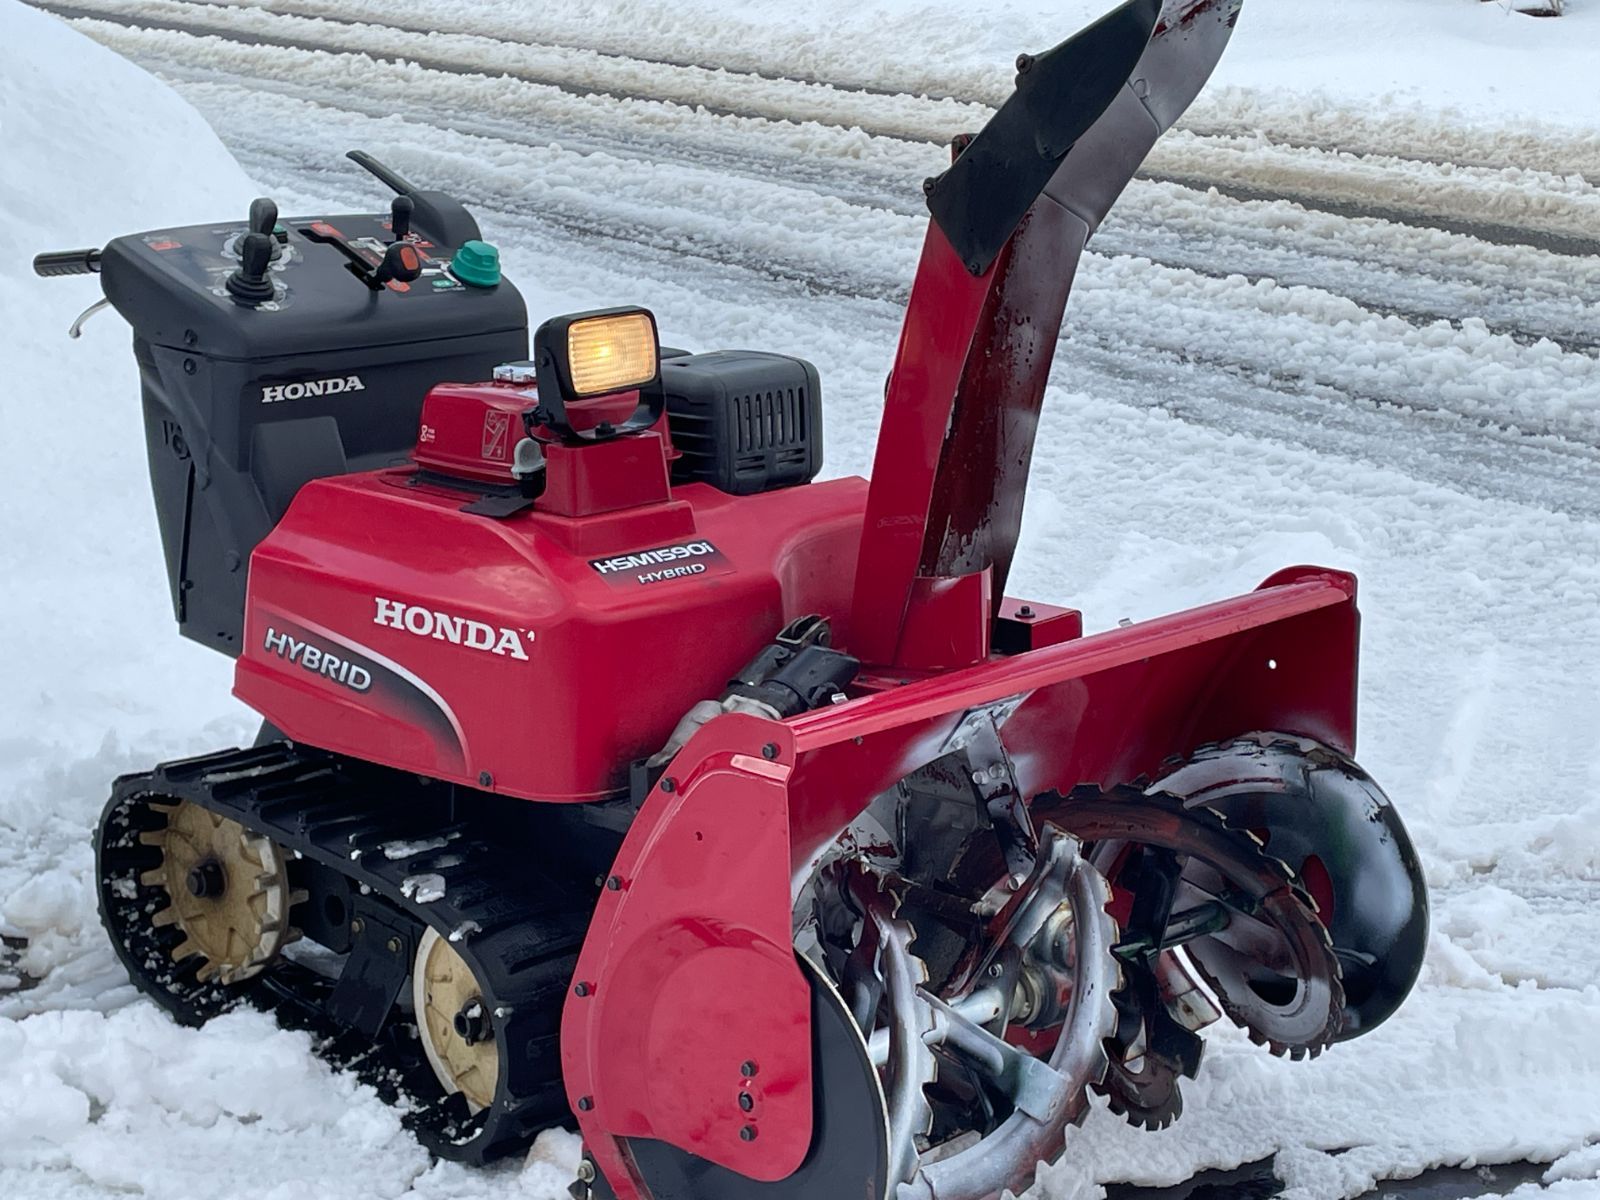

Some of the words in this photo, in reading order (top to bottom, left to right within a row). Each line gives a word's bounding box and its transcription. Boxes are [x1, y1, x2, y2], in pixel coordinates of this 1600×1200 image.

[262, 375, 365, 403] HONDA
[593, 542, 714, 574] HSM1590i
[638, 563, 706, 584] HYBRID
[373, 597, 529, 661] HONDA
[264, 627, 371, 690] HYBRID
